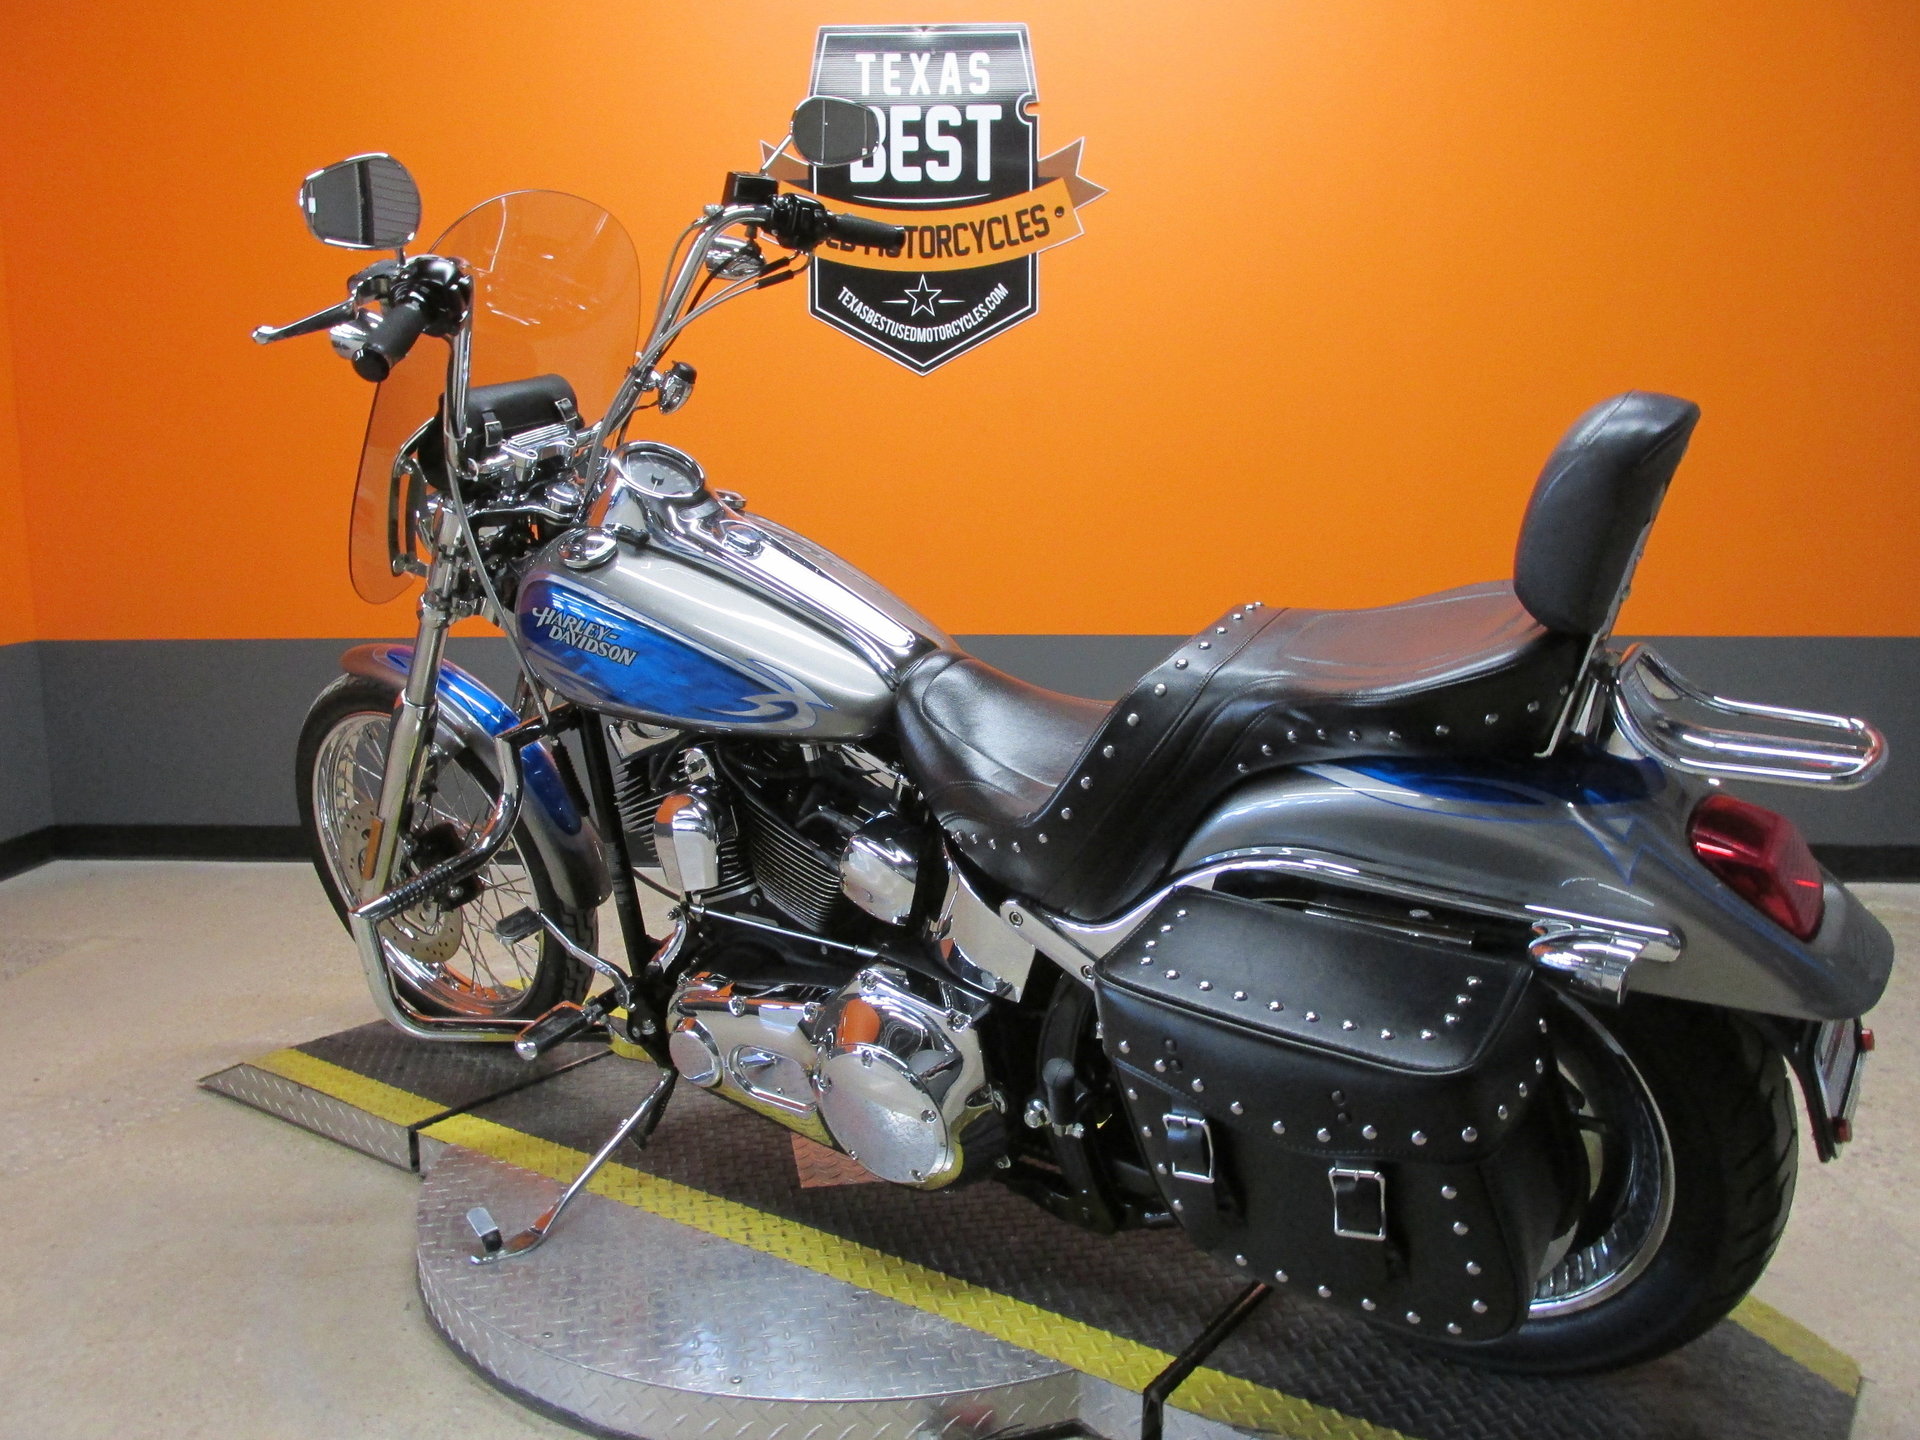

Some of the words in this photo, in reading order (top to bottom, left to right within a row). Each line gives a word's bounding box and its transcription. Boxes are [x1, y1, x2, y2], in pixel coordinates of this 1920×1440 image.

[855, 52, 990, 95] TEXAS
[865, 204, 1050, 258] TORCYCLES
[837, 282, 1009, 343] TEXASBESTUSEDMOTORCYCLES.COM
[532, 606, 620, 641] HARLEY-
[549, 625, 639, 667] DAVIDSON
